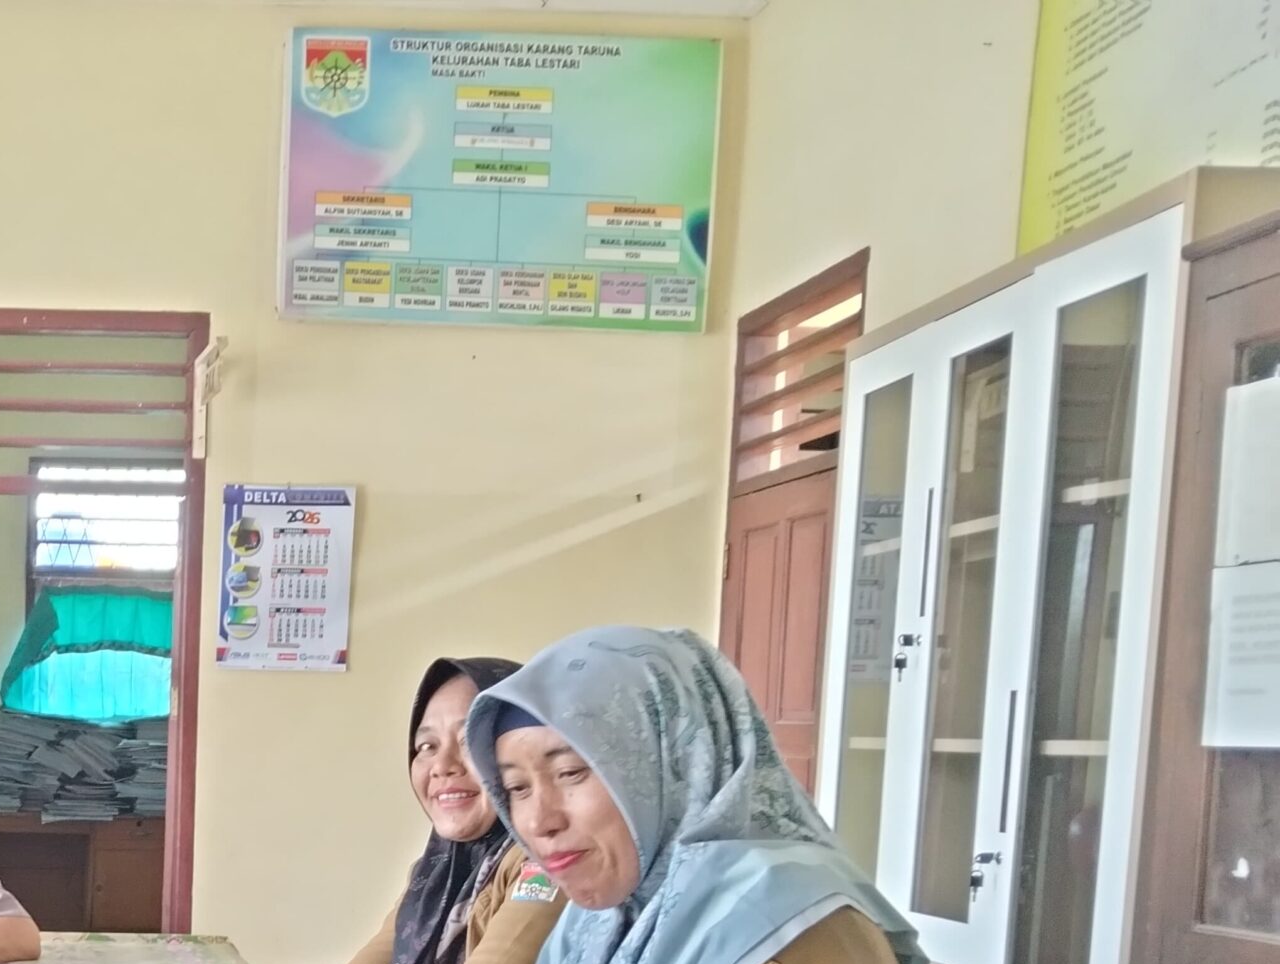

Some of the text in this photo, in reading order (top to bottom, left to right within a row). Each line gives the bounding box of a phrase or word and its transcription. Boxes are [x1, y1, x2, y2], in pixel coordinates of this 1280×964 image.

[392, 39, 621, 57] STRUKTUR ORGANISASI KARANG TARUNA
[431, 56, 581, 69] KELURAHAN TABA LESTARI
[431, 69, 486, 78] MASA BAKTI
[243, 491, 287, 503] DELTA
[286, 509, 321, 525] 2026
